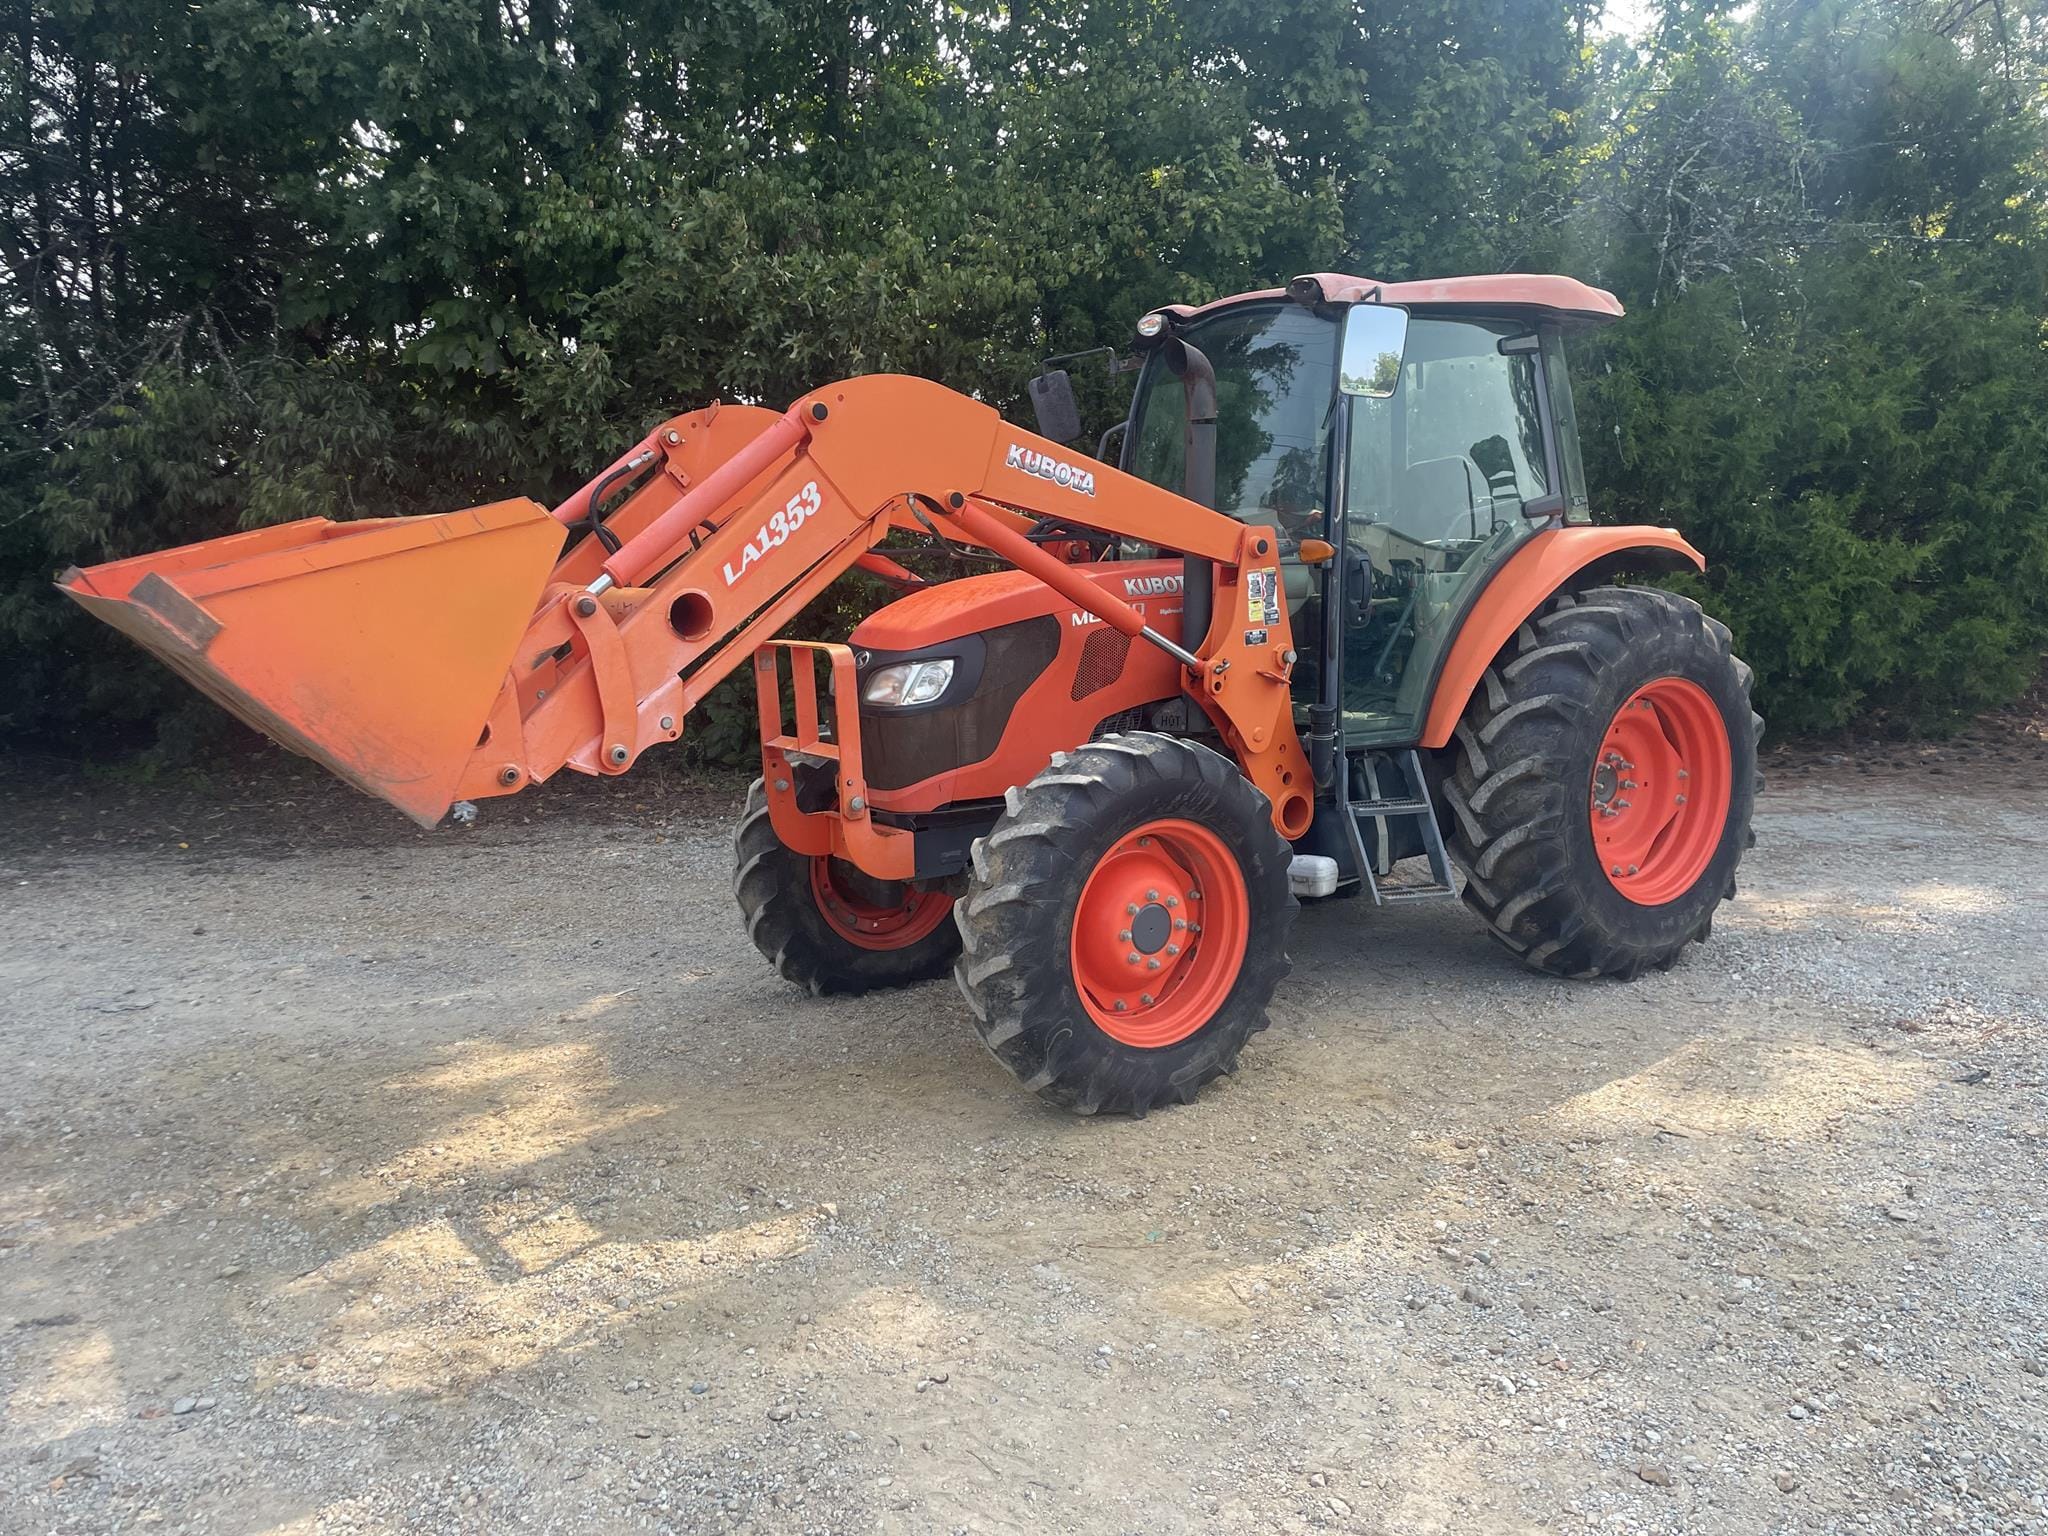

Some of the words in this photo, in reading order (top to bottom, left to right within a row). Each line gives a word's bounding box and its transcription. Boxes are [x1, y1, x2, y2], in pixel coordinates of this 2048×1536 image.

[1007, 443, 1095, 496] KUBOTA
[722, 481, 822, 587] LA1353
[1123, 575, 1184, 596] KUBOT
[1161, 714, 1181, 728] HOT
